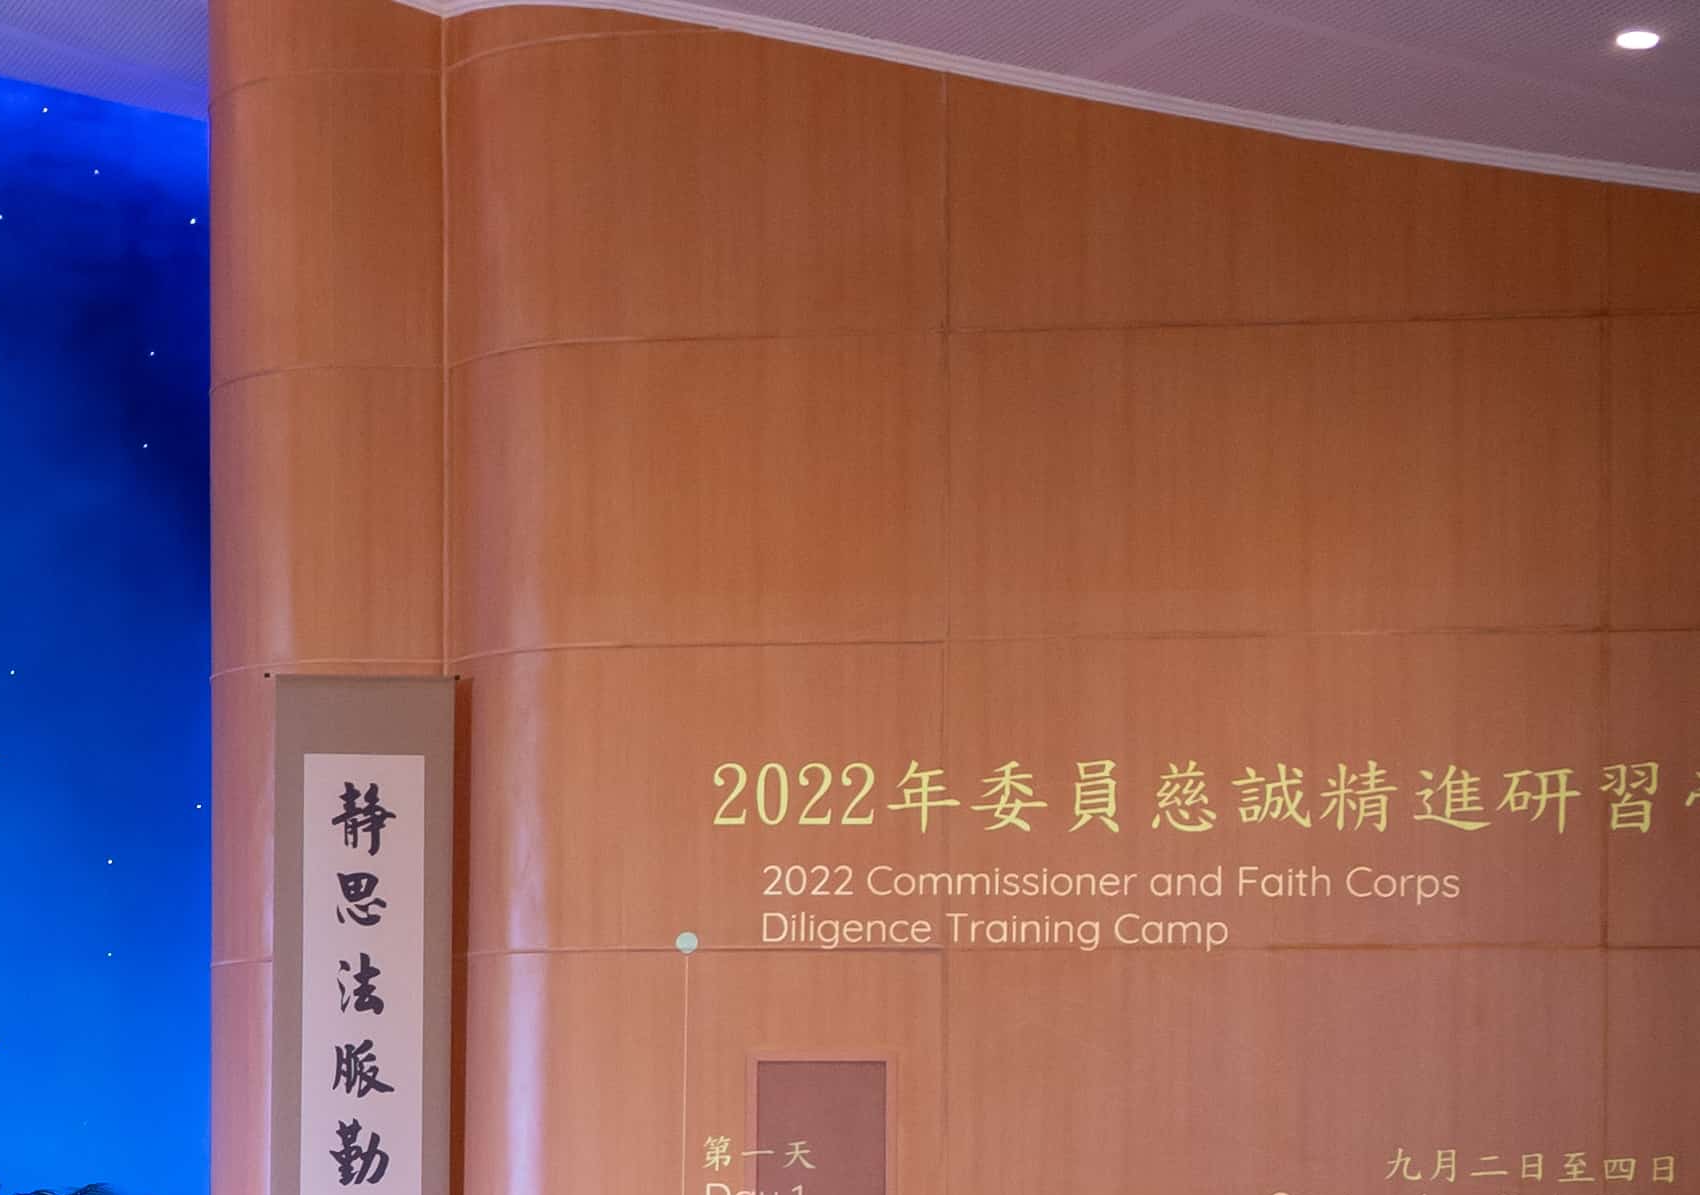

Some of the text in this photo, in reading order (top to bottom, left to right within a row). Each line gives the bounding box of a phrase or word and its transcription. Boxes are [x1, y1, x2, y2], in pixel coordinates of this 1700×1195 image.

[712, 759, 1700, 834] 2022年委員慈誠精進研習
[761, 864, 1462, 905] 2022 Commissioner and Faith Corps
[761, 911, 1229, 952] Diligence Training Camp
[702, 1135, 817, 1172] 第一天
[1384, 1146, 1676, 1185] 九月二日至四日
